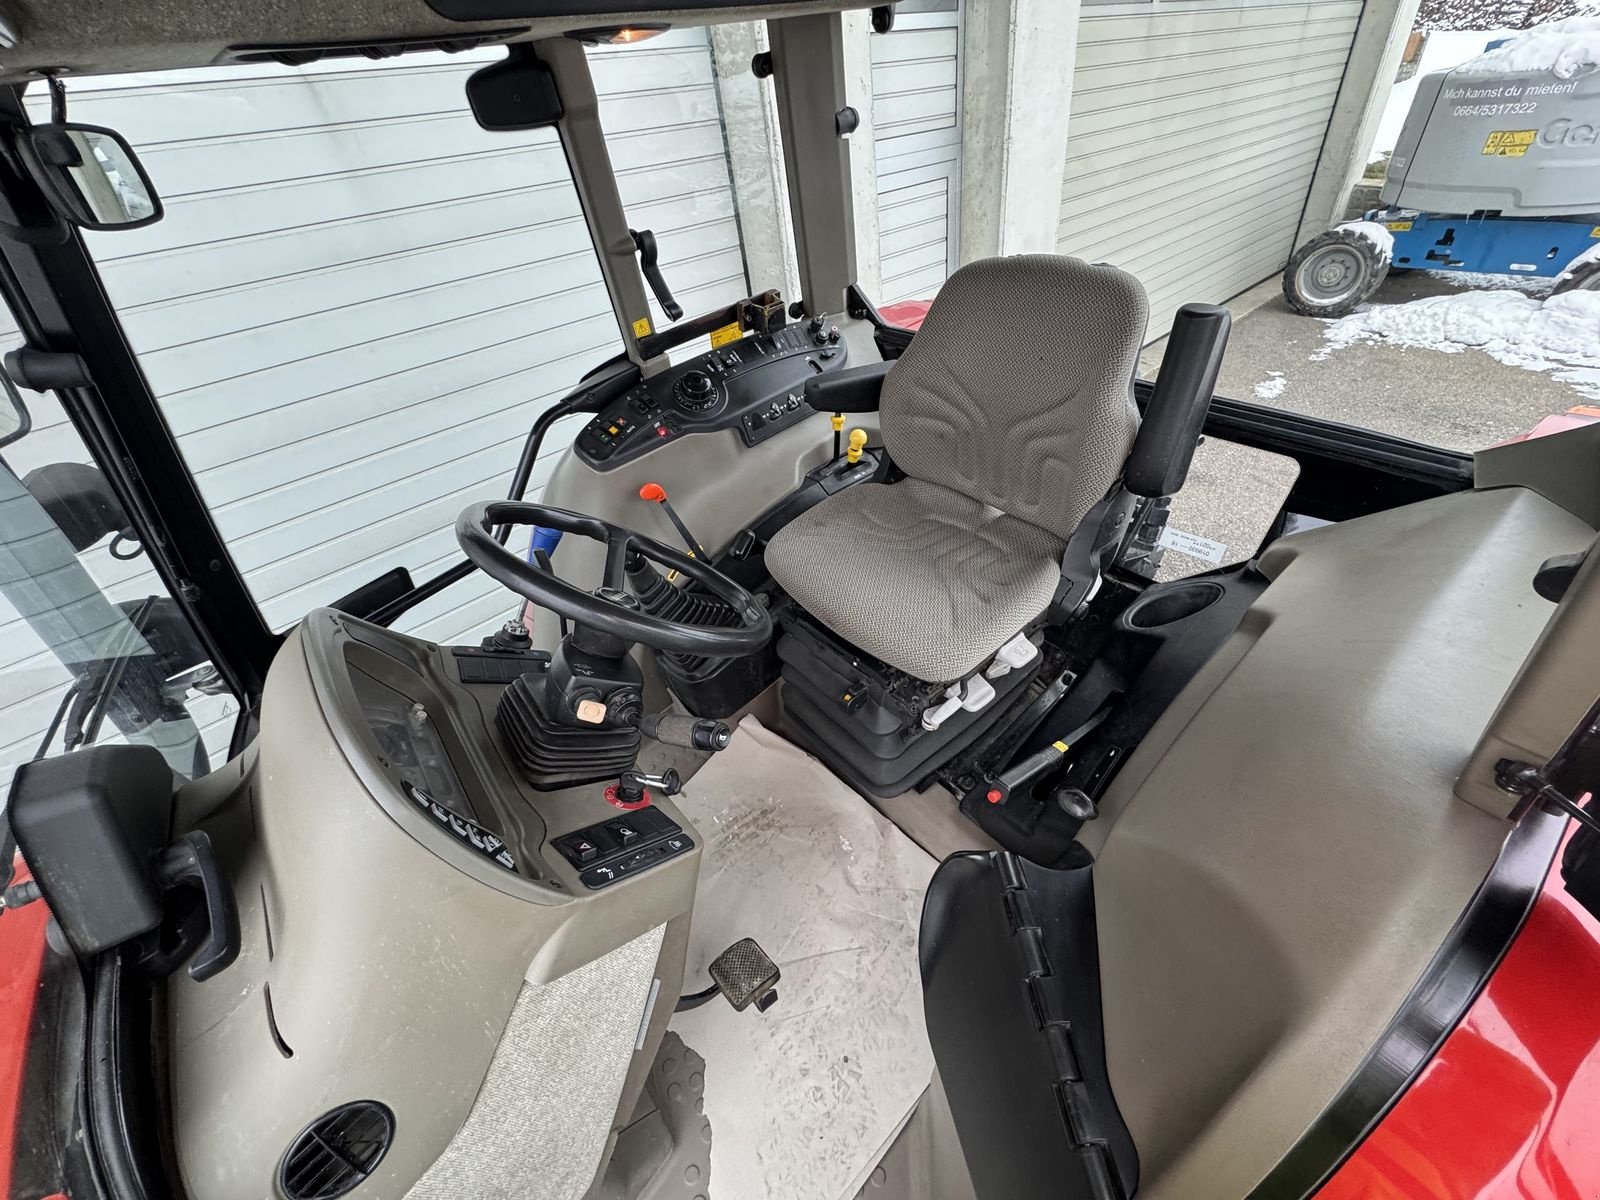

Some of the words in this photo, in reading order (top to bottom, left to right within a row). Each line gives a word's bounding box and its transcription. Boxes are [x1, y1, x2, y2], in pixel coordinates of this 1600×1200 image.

[1444, 88, 1464, 99] Mich
[1464, 86, 1501, 99] kannst
[1504, 84, 1522, 97] du
[1525, 81, 1578, 95] mieten!
[1453, 102, 1538, 116] 0664/5317322
